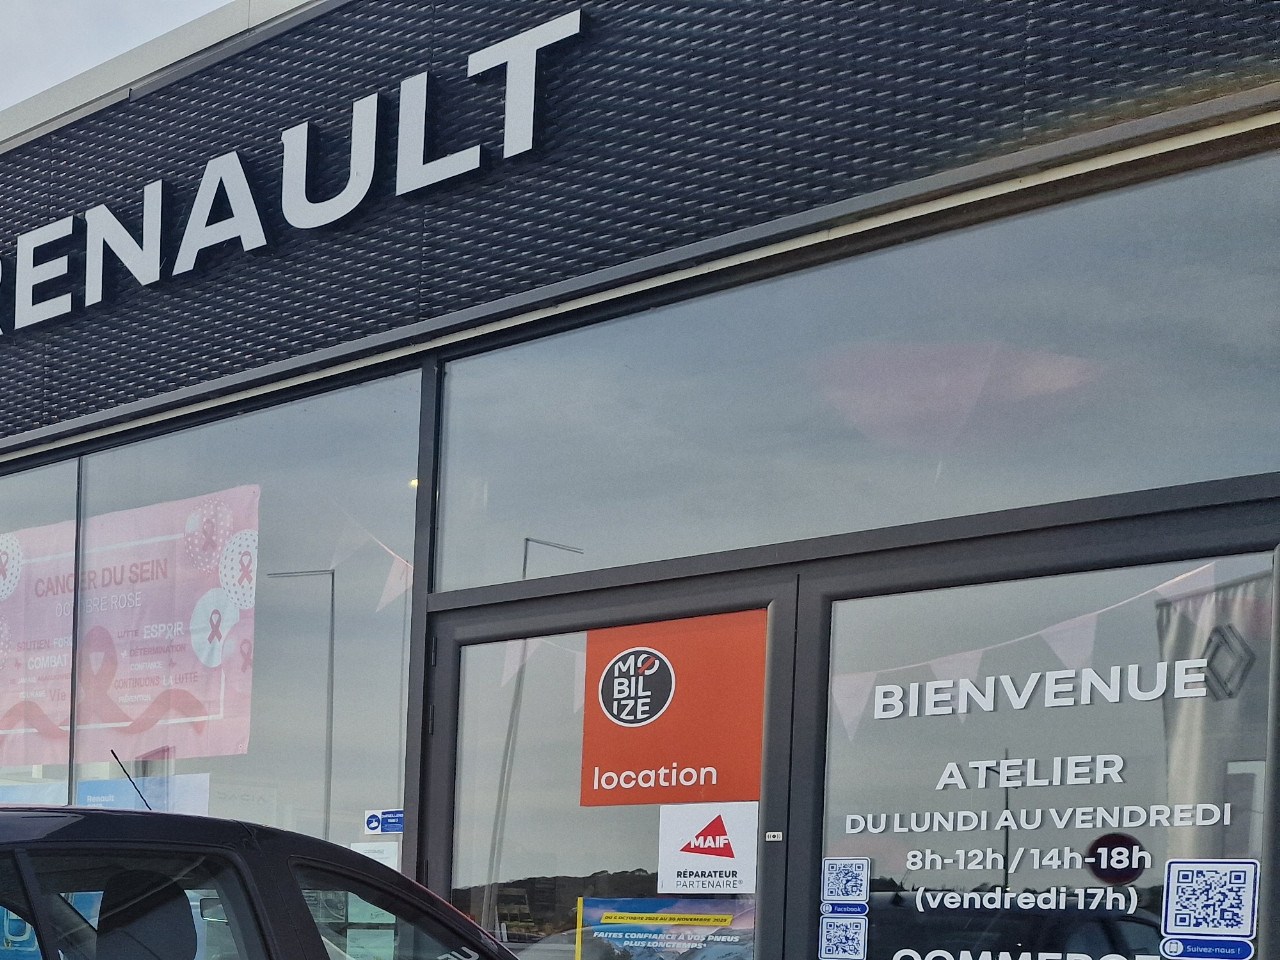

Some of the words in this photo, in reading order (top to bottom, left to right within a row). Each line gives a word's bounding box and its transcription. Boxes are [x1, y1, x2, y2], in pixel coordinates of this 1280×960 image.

[101, 565, 125, 588] DU
[128, 558, 169, 585] SEIN
[110, 592, 142, 610] ROSE
[27, 653, 69, 670] COMBAT
[174, 672, 198, 684] LUTTE
[873, 659, 1208, 719] BIENVENUE
[593, 763, 717, 790] location
[935, 753, 1125, 790] ATELIER
[86, 794, 115, 803] Renault
[845, 813, 888, 834] DU
[892, 810, 987, 833] LUNDI
[994, 807, 1043, 831] AU
[1049, 803, 1232, 830] VENDREDI
[690, 835, 729, 848] MAIF
[906, 849, 1004, 872] 8h-12h
[1009, 847, 1023, 874] /
[1030, 846, 1152, 870] 14h-18h
[676, 869, 738, 879] RÉPARATEUR
[914, 886, 1068, 913] (vendredi
[1074, 887, 1140, 914] 17h)
[593, 931, 623, 939] FAITES
[624, 932, 677, 941] CONFIANCE
[687, 934, 705, 942] VOS
[1186, 945, 1235, 954] Suivez-nous
